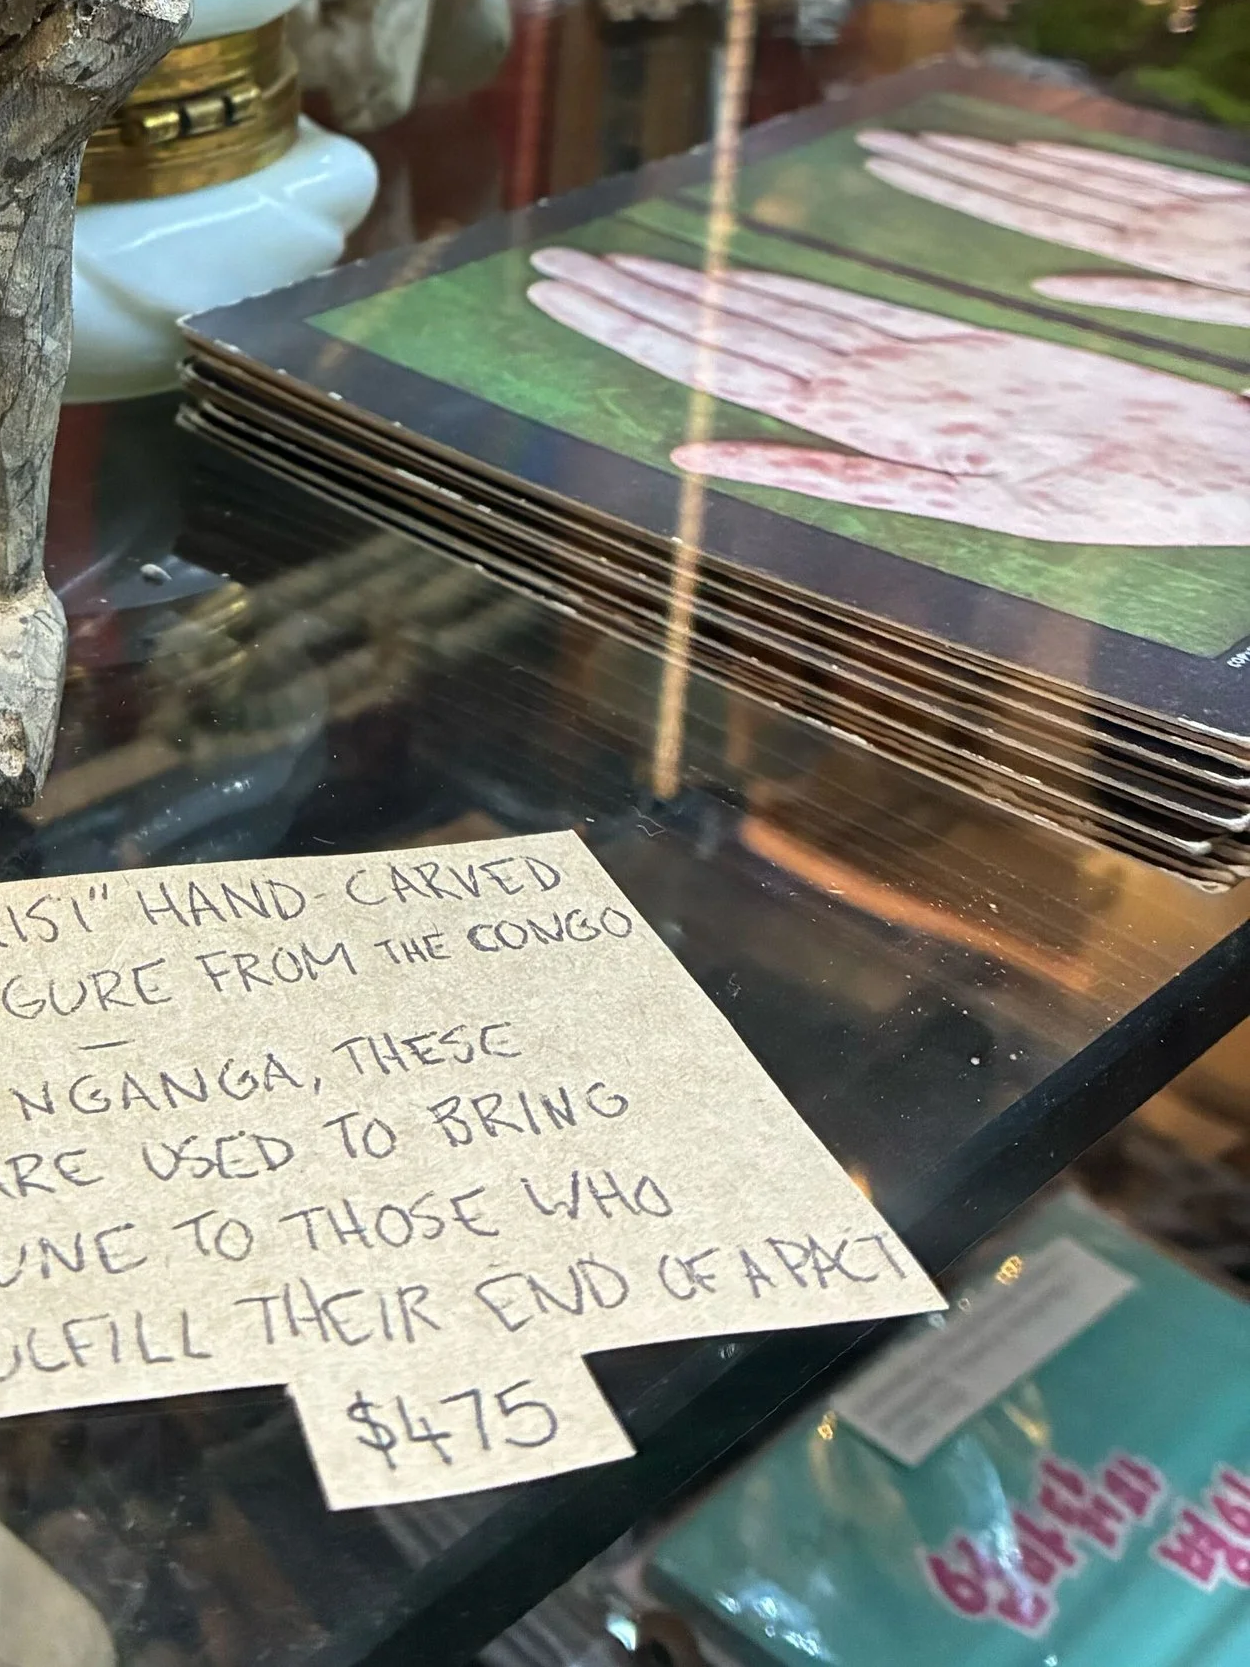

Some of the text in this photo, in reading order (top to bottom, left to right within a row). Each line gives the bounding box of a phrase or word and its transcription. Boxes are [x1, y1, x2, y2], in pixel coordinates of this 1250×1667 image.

[196, 943, 356, 993] FROM
[375, 932, 452, 965] THE
[467, 906, 633, 953] CONGO
[11, 1052, 321, 1122] NGANGA,
[332, 1021, 522, 1077] THESE
[142, 1130, 294, 1182] USED
[325, 1111, 397, 1161] TO
[427, 1082, 628, 1149] BRING
[172, 1210, 253, 1262] TO
[280, 1184, 500, 1250] THOSE
[522, 1169, 673, 1220] WHO
[234, 1277, 443, 1347] THEIR
[476, 1258, 630, 1333] END
[658, 1246, 721, 1301] OF
[739, 1248, 777, 1299] A
[765, 1232, 908, 1290] PACT
[347, 1379, 560, 1471] $475
